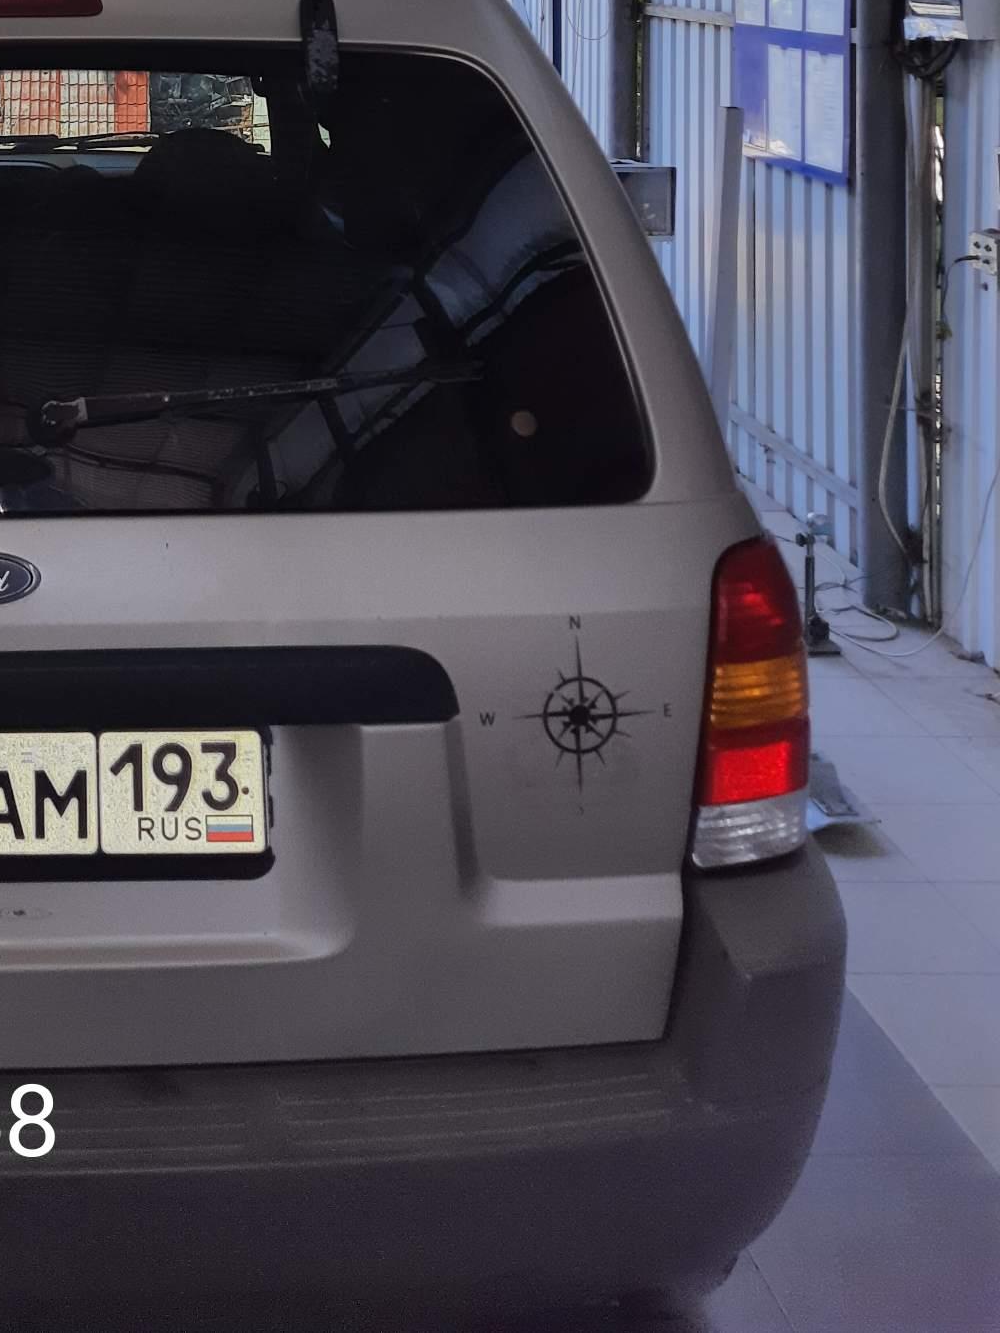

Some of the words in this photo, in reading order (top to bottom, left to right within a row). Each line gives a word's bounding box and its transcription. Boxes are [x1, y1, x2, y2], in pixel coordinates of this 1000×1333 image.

[568, 615, 581, 630] N
[479, 711, 496, 727] W
[110, 742, 239, 812] 193
[138, 817, 202, 842] RUS
